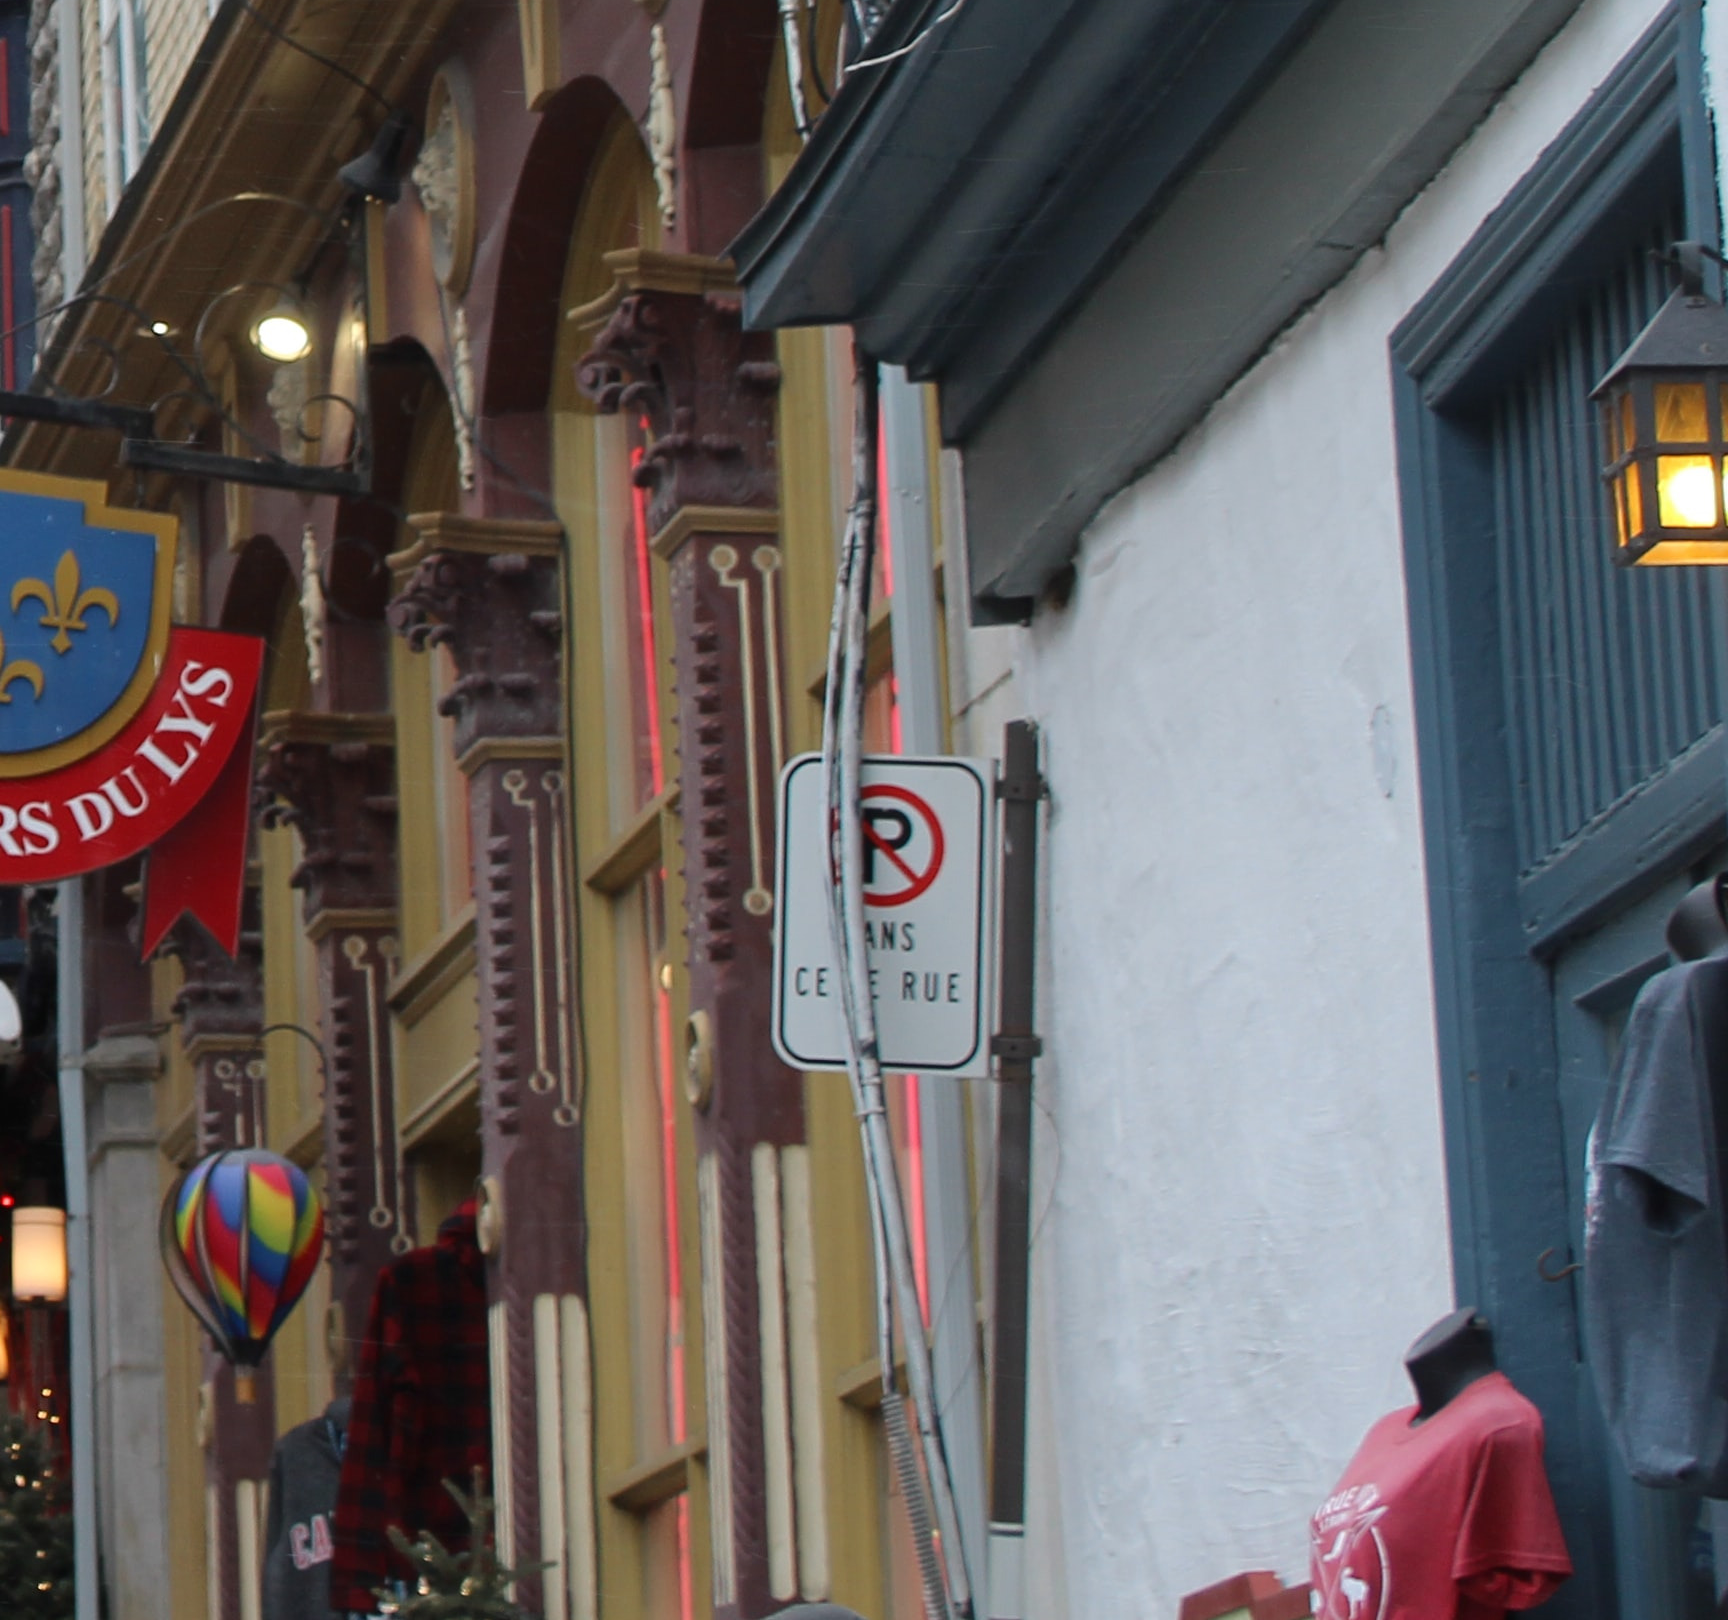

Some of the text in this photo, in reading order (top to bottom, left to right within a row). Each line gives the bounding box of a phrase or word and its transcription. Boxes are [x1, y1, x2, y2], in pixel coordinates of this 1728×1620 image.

[67, 766, 150, 844] DU
[137, 660, 236, 785] LYS
[865, 920, 915, 952] ANS
[795, 967, 961, 1003] CEE RUE
